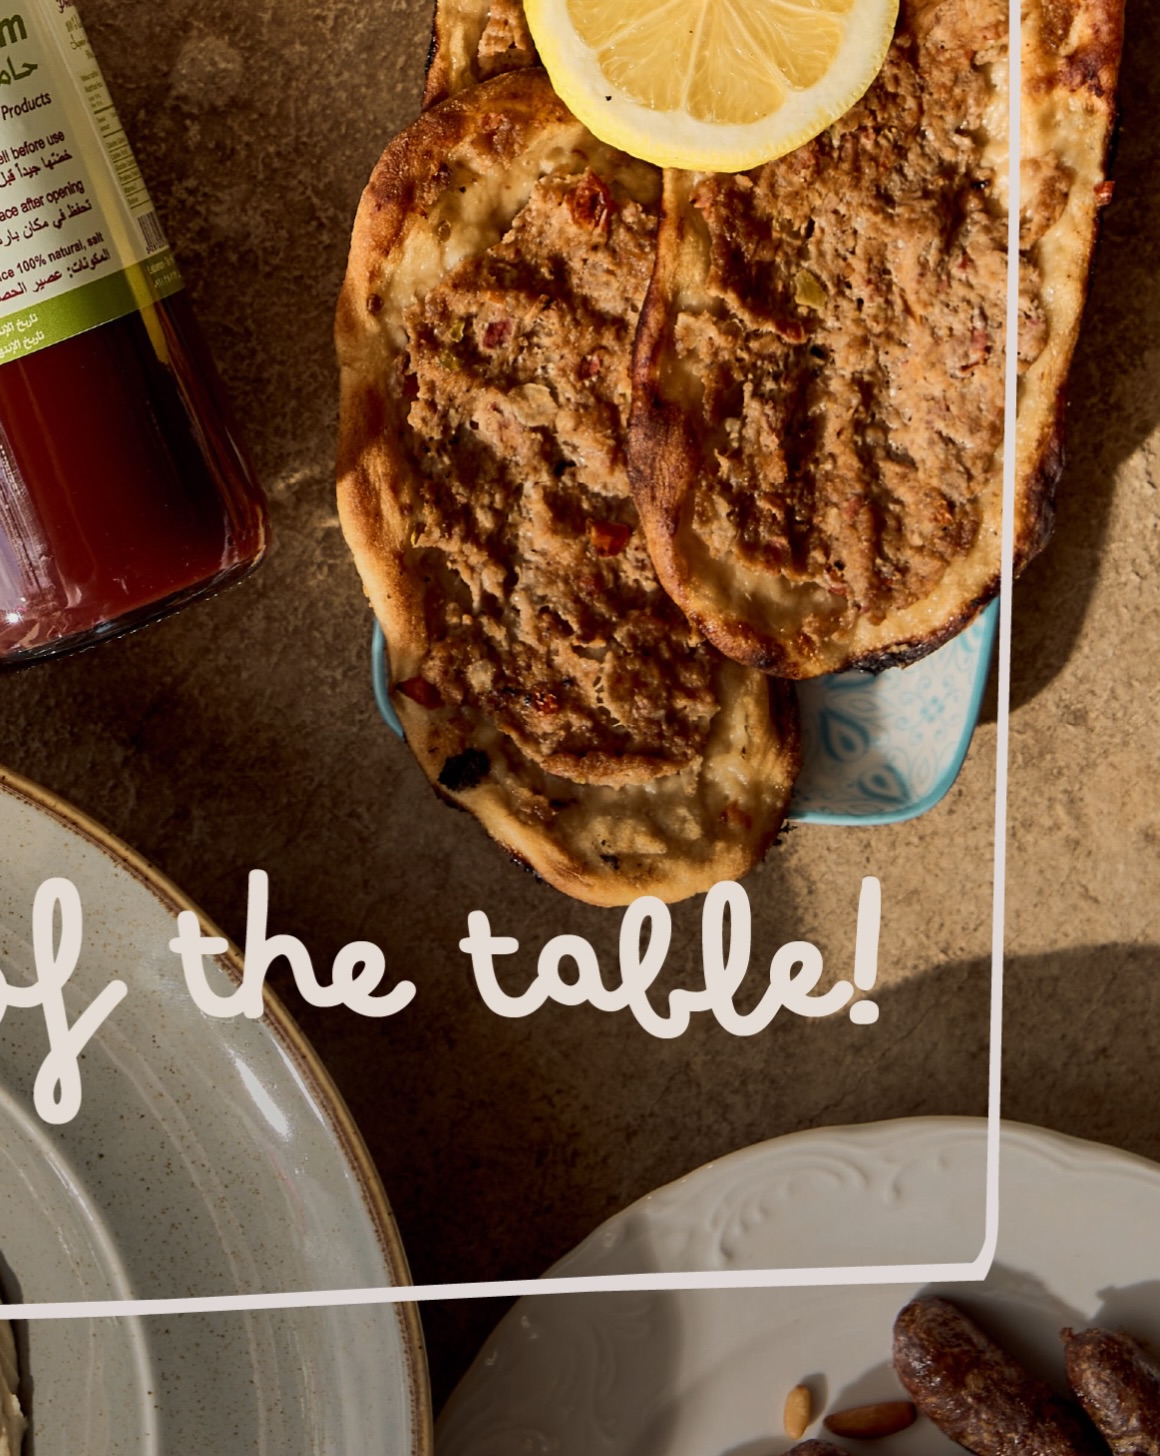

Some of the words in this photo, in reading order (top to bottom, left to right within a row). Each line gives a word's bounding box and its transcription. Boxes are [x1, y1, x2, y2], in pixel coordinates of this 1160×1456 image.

[1, 93, 52, 121] Products
[10, 138, 46, 160] before
[46, 130, 66, 146] use
[20, 195, 45, 214] after
[46, 179, 85, 204] opening
[22, 217, 49, 239] مكان
[52, 208, 67, 230] في
[17, 252, 46, 273] 100%
[48, 240, 88, 262] natural,
[87, 231, 104, 248] salt
[68, 248, 111, 278] المكونات:
[32, 268, 63, 293] عصير
[16, 313, 38, 331] تاريخ
[22, 331, 45, 350] تاريخ
